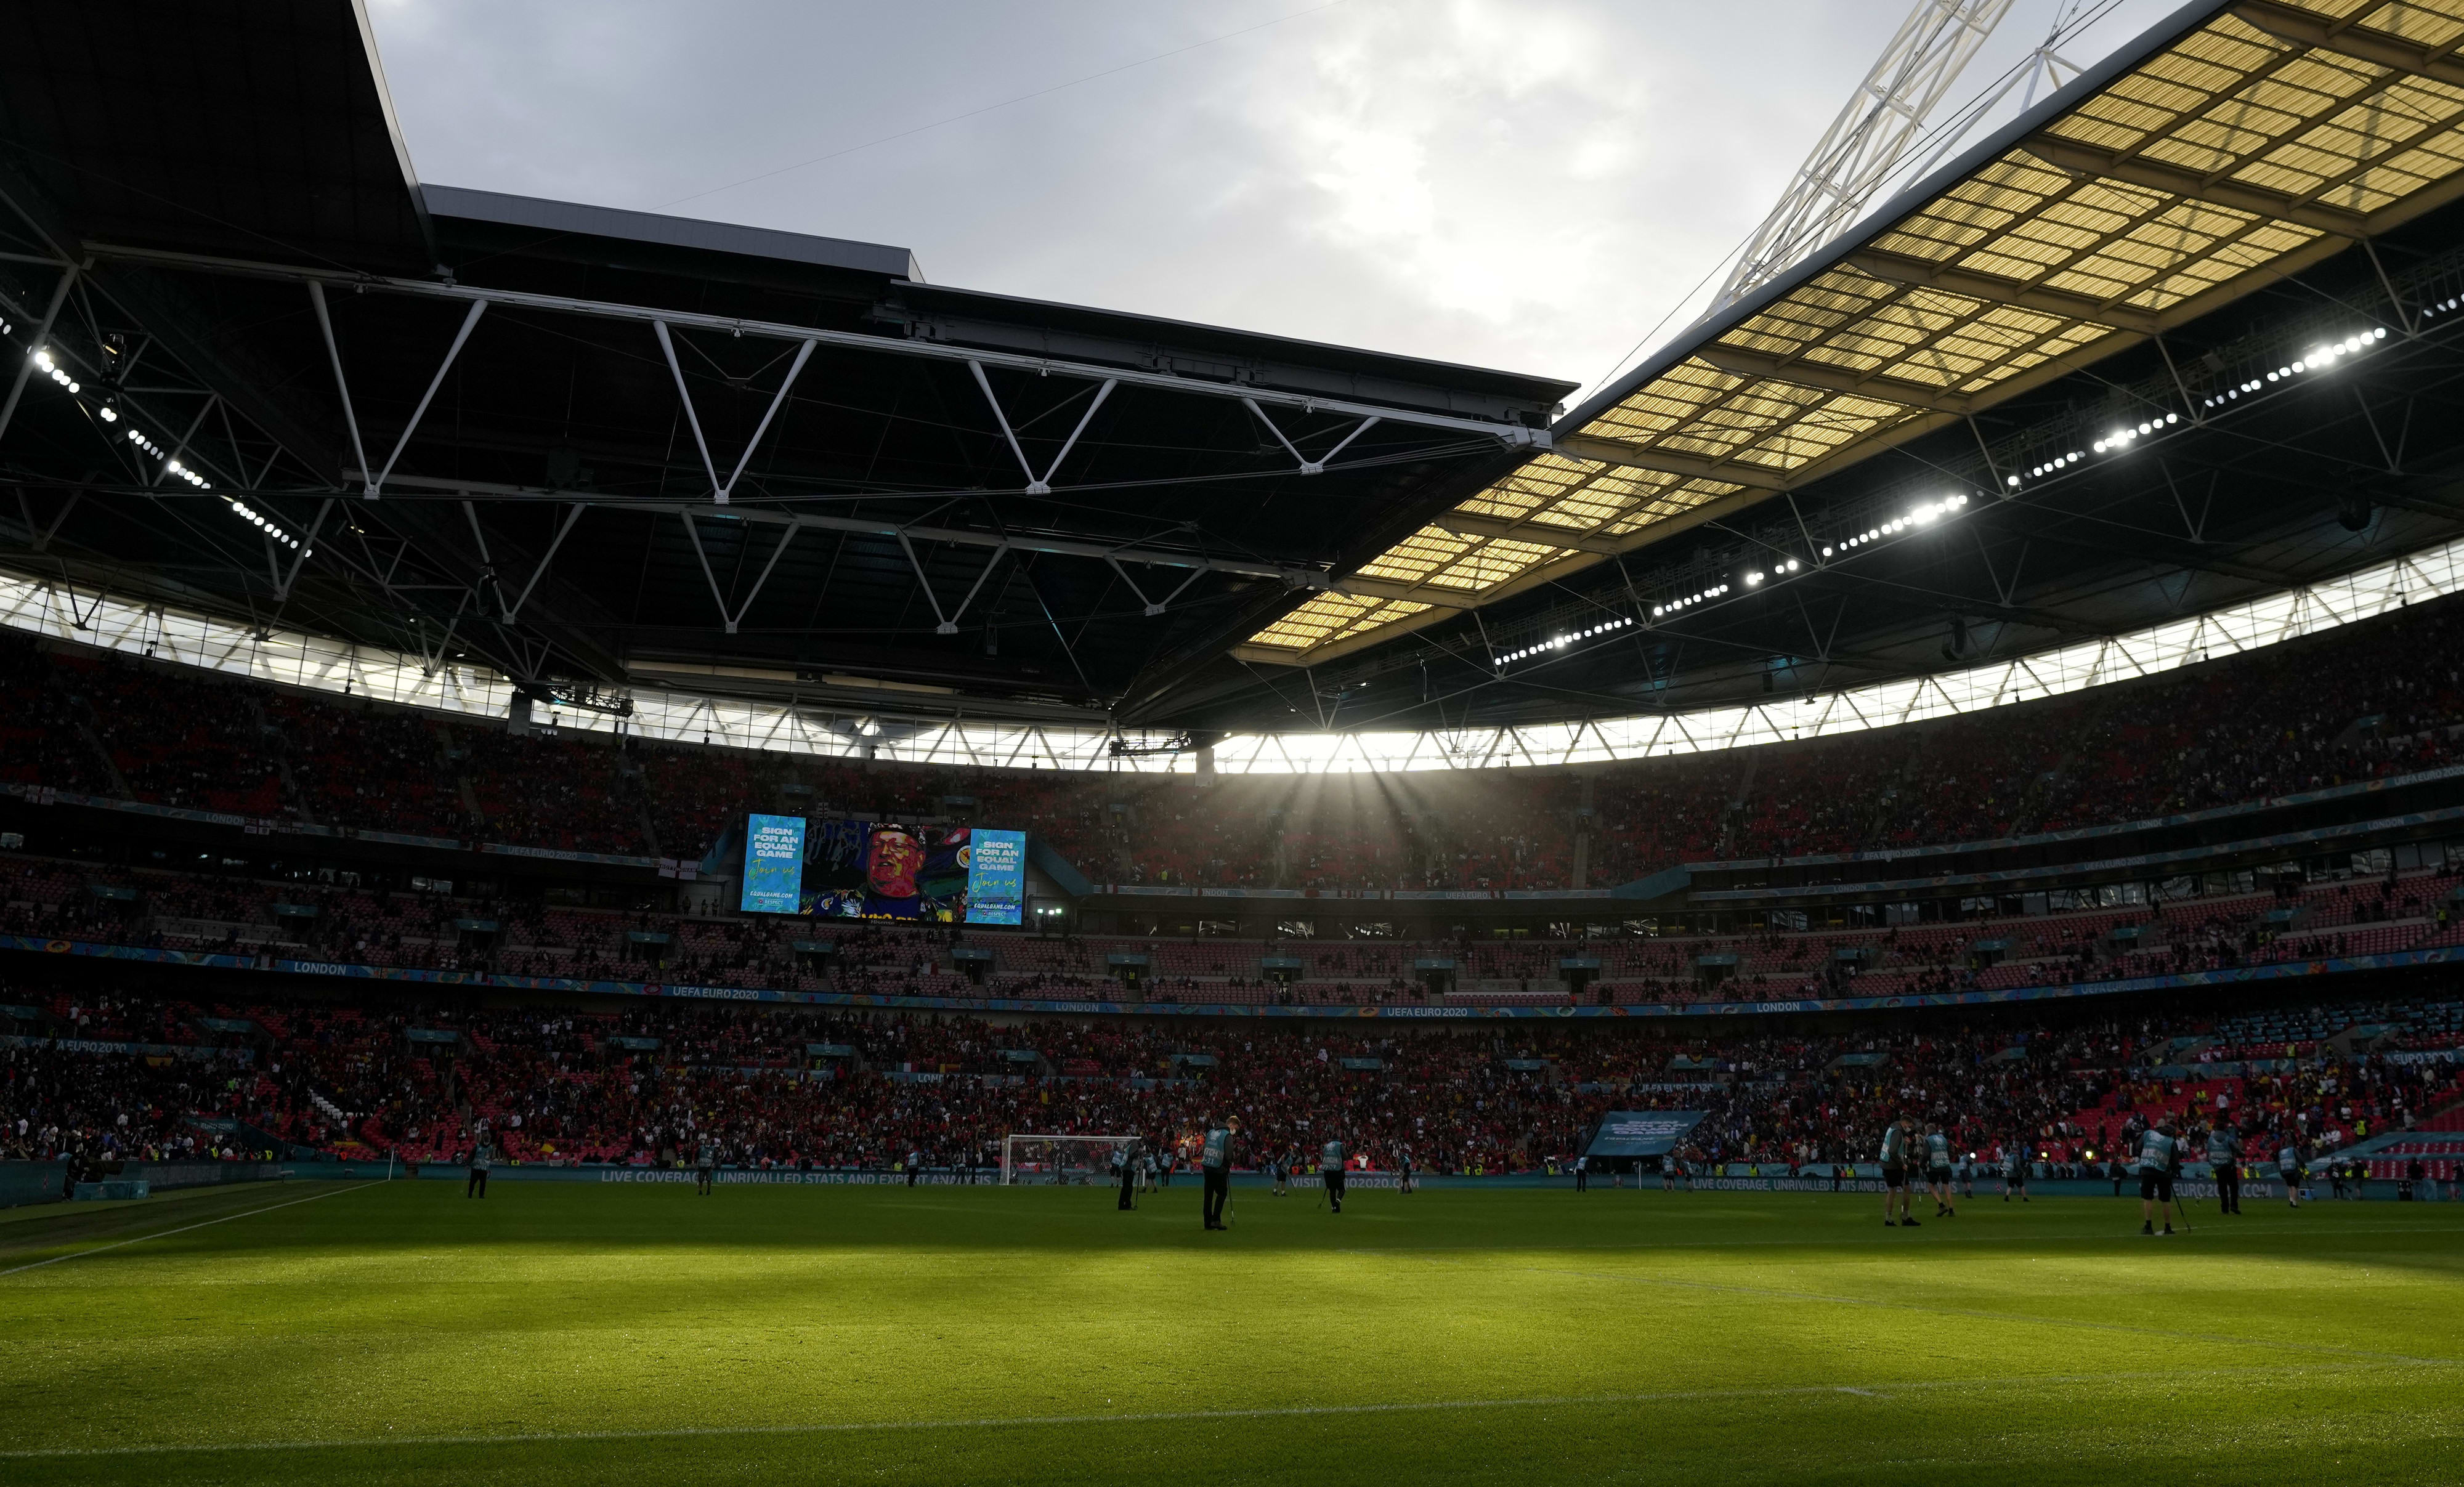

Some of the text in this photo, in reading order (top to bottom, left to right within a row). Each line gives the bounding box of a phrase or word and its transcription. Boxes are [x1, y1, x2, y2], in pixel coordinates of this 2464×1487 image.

[761, 827, 793, 835] SIGN
[753, 834, 798, 844] FOR AN
[754, 841, 796, 851] EQUAL
[983, 841, 1013, 849] SIGN
[756, 850, 793, 859] GAME
[1862, 852, 1879, 861] EFA
[977, 856, 1016, 864] EQUAL
[979, 864, 1015, 872] GAME
[972, 872, 1016, 893] Join us
[750, 891, 793, 899] EQUALGAME.COM
[294, 961, 346, 976] LONDON
[673, 986, 759, 1000] UEFA EURO 2020
[1056, 1002, 1099, 1012] LONDON
[1387, 1007, 1468, 1016] UEFA EURO 2020
[1757, 1001, 1801, 1013] LONDON
[34, 1038, 65, 1050] UEA
[918, 1074, 944, 1084] LOND
[601, 1171, 631, 1182] LIVE
[636, 1171, 705, 1183] COVERAG
[717, 1172, 801, 1184] UNRIVALLED
[805, 1173, 845, 1184] STATS
[848, 1173, 875, 1184] AND
[931, 1175, 991, 1185] ANAYSIS
[1291, 1177, 1321, 1188] VISIT
[1692, 1178, 1714, 1189] LIVE
[1716, 1179, 1771, 1192] COVERAGE,
[1774, 1180, 1830, 1191] UNRIVALLED
[1832, 1180, 1856, 1191] SATS
[1858, 1181, 1876, 1191] AND
